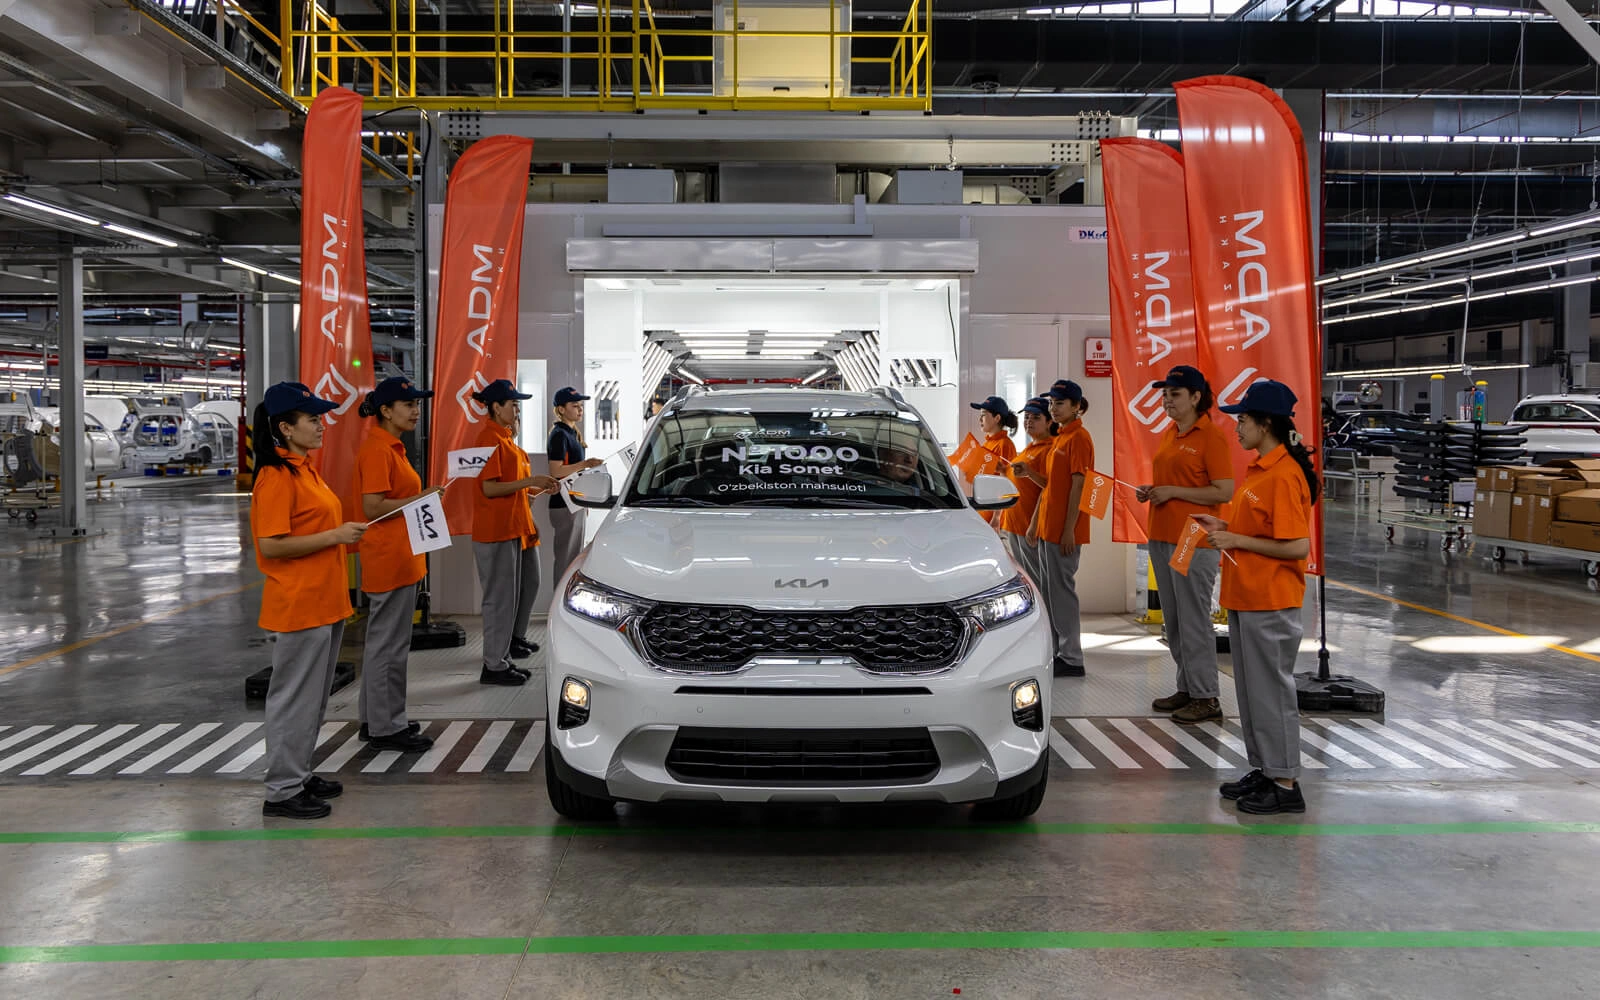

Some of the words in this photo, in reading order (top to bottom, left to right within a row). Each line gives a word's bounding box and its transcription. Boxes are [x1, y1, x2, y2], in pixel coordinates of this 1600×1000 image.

[320, 212, 338, 347] ADM
[467, 244, 493, 357] ADM
[769, 445, 859, 462] 1000
[739, 464, 772, 475] Kia
[779, 464, 843, 475] Sonet
[801, 482, 866, 492] mahsuloti
[420, 503, 438, 539] KIA
[775, 579, 829, 588] KIA
